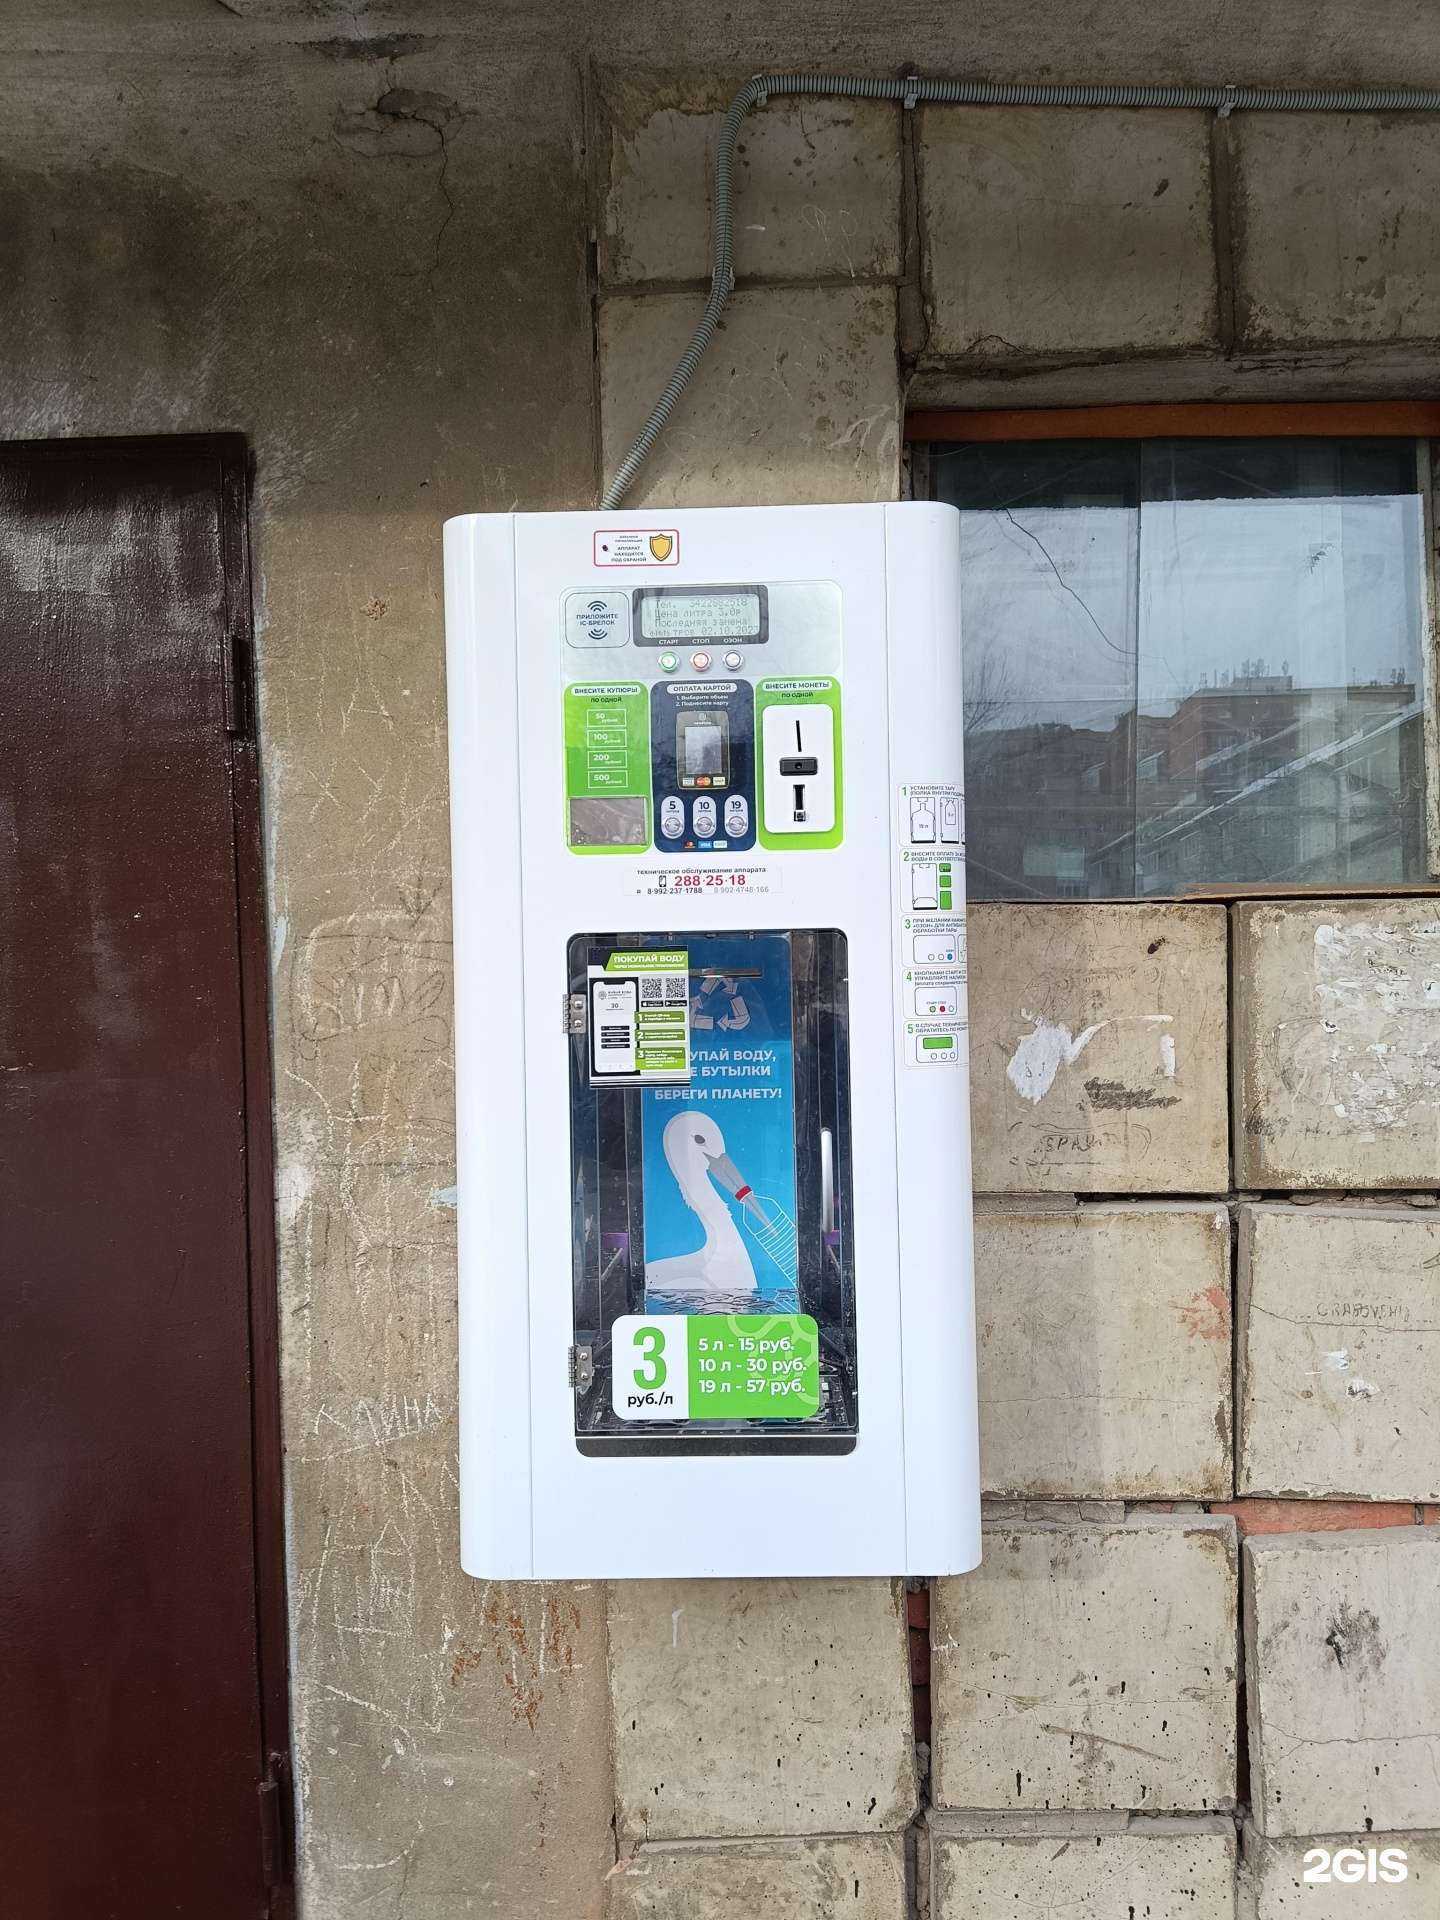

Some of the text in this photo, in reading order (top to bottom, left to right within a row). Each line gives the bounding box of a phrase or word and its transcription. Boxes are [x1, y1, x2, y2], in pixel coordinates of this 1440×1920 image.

[655, 618, 707, 628] Последняя
[902, 786, 907, 796] 1
[669, 801, 676, 809] 5
[700, 801, 710, 809] 10
[731, 801, 741, 809] 19
[904, 851, 910, 861] 2
[905, 919, 911, 929] 3
[614, 954, 685, 964] ПОКУПАЙ ВОДУ
[906, 971, 912, 981] 4
[907, 1023, 914, 1033] 5
[638, 1031, 644, 1039] 2
[638, 1050, 644, 1058] 3
[689, 1048, 729, 1061] УПАЙ
[734, 1048, 776, 1062] ВОДУ,
[690, 1066, 770, 1076] Е БУТЫЛКИ
[655, 1088, 782, 1100] БЕРЕГИ ПЛАНЕТУ!
[699, 1338, 708, 1351] 5
[711, 1341, 723, 1351] л
[738, 1338, 755, 1350] 15
[759, 1337, 795, 1353] руб.
[633, 1326, 667, 1390] 3
[699, 1359, 716, 1372] 10
[720, 1362, 732, 1372] л
[746, 1359, 767, 1372] 30
[772, 1357, 807, 1375] руб.
[699, 1379, 715, 1393] 19
[720, 1382, 731, 1392] л
[746, 1380, 766, 1392] 57
[771, 1378, 806, 1396] руб.
[627, 1392, 673, 1407] руб./л
